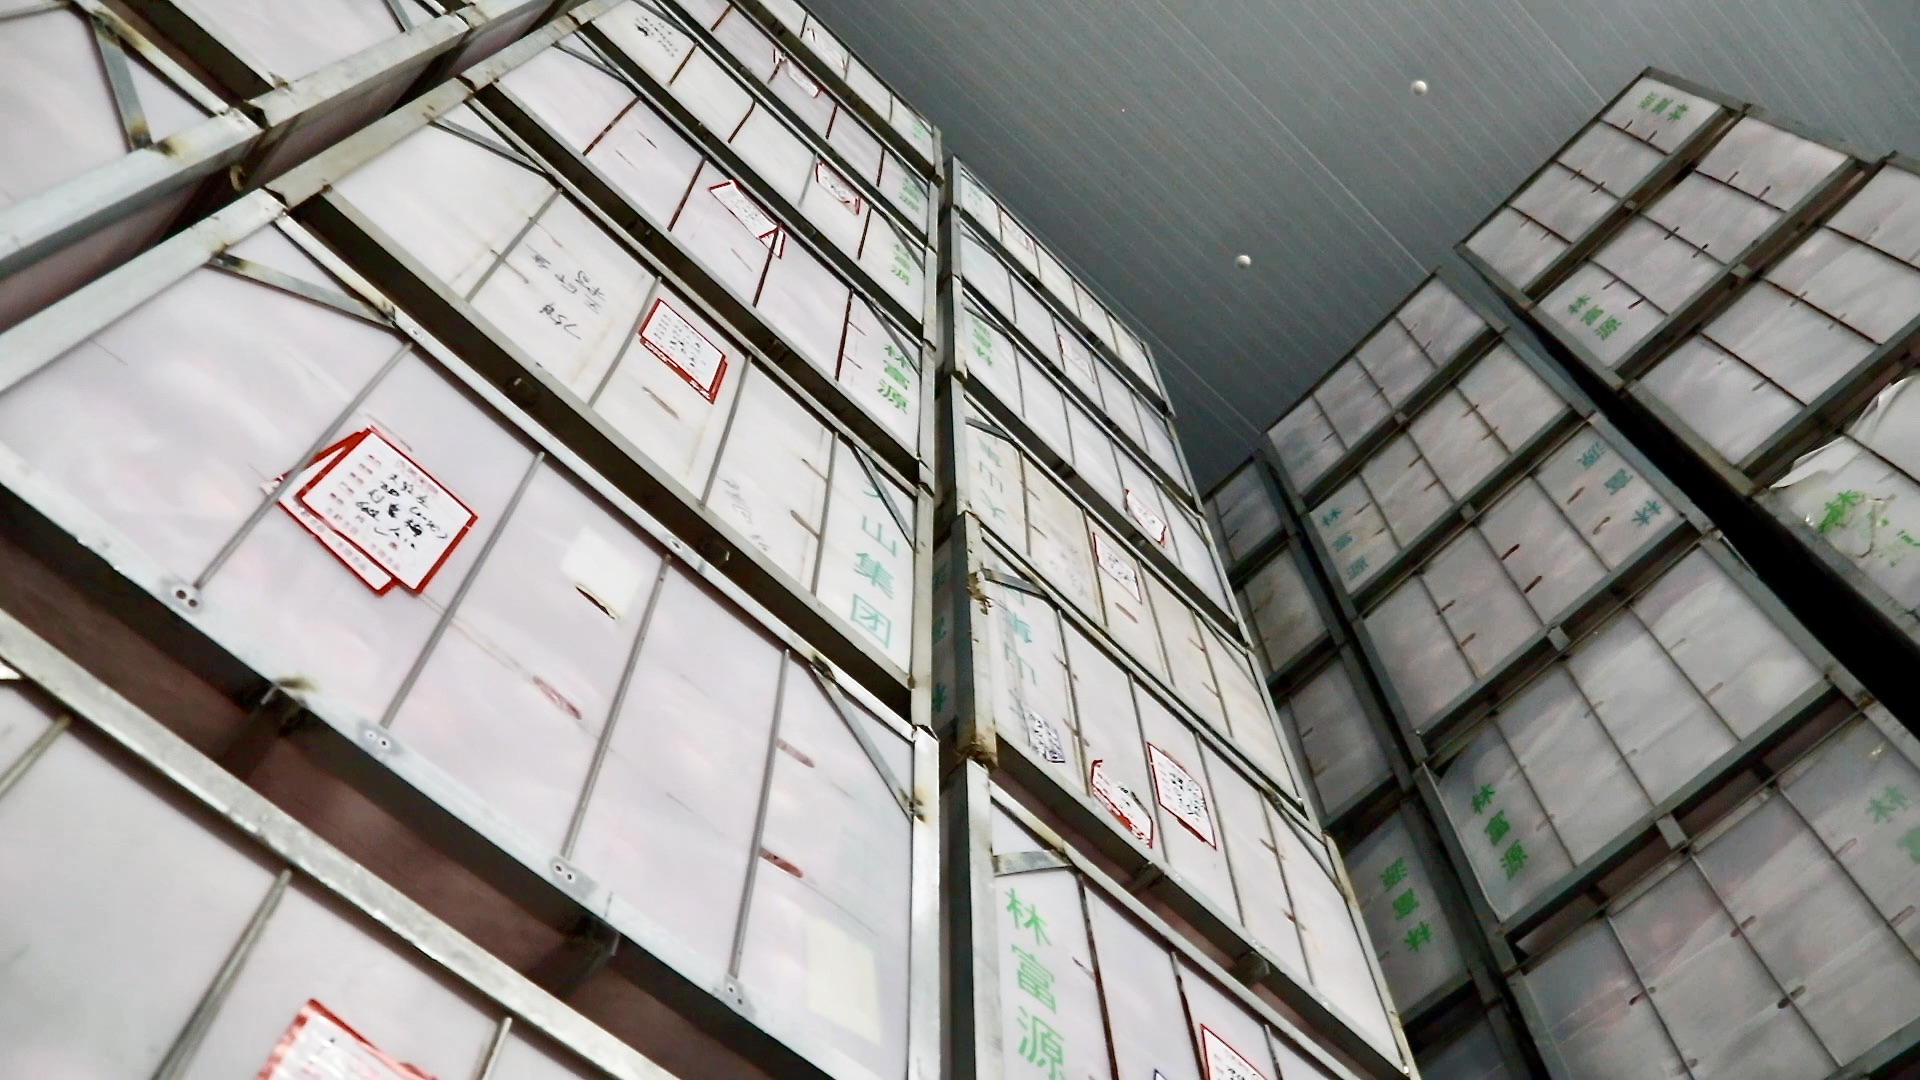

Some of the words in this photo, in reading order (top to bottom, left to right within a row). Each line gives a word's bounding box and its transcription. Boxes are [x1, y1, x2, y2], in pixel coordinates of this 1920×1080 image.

[1568, 294, 1623, 341] 林富源
[877, 344, 910, 415] 林富源
[1576, 440, 1661, 528] 林富源
[1471, 783, 1528, 881] 林富源
[1379, 857, 1433, 952] 林富源
[1004, 887, 1067, 1080] 林富源
